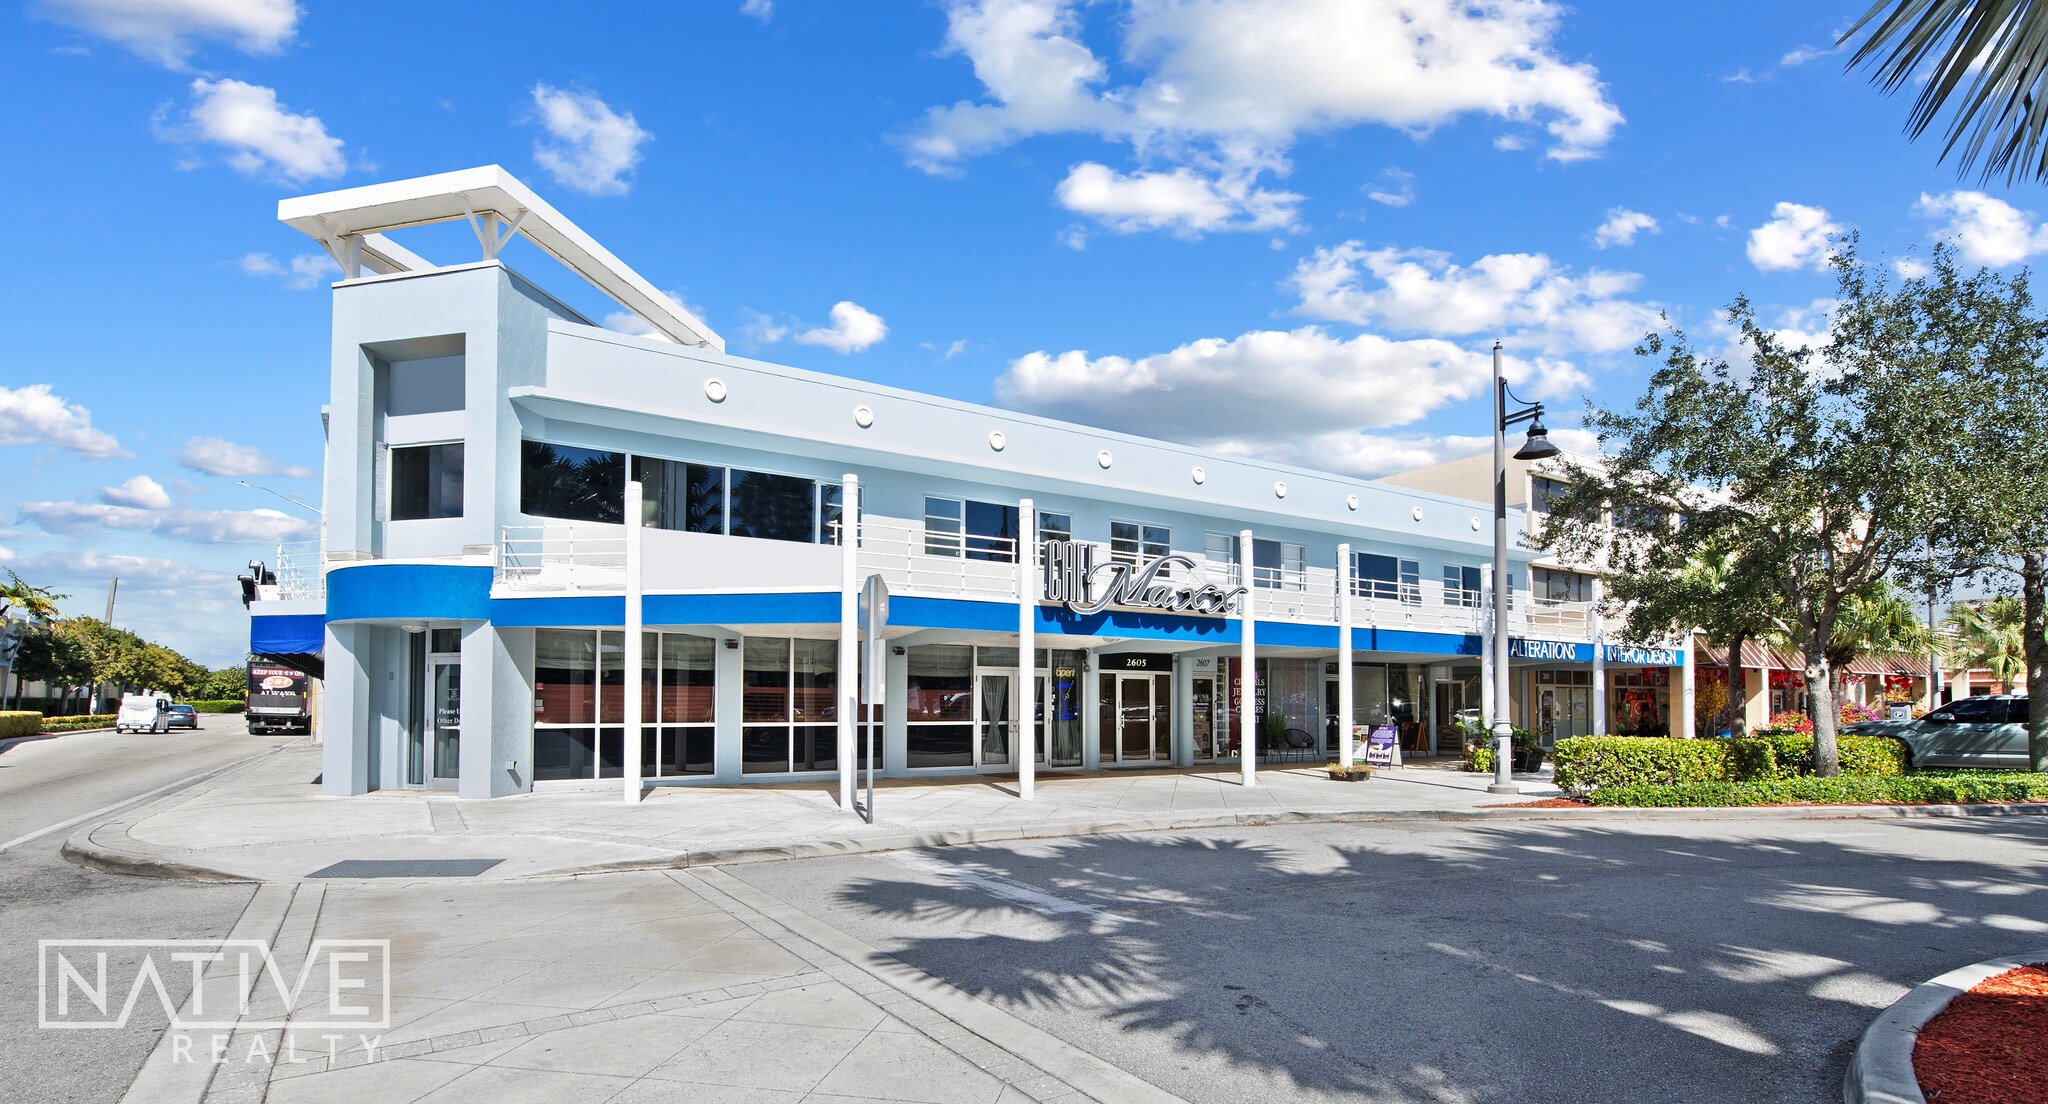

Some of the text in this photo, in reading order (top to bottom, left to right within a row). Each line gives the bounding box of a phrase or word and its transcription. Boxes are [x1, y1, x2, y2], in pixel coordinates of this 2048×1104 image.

[1063, 555, 1249, 616] Maxx
[1511, 641, 1575, 660] ALTERATIONS
[1607, 646, 1676, 665] INTERIOR DESIGN
[1126, 658, 1147, 667] 2605
[1196, 659, 1210, 667] 2607
[1055, 668, 1075, 677] open
